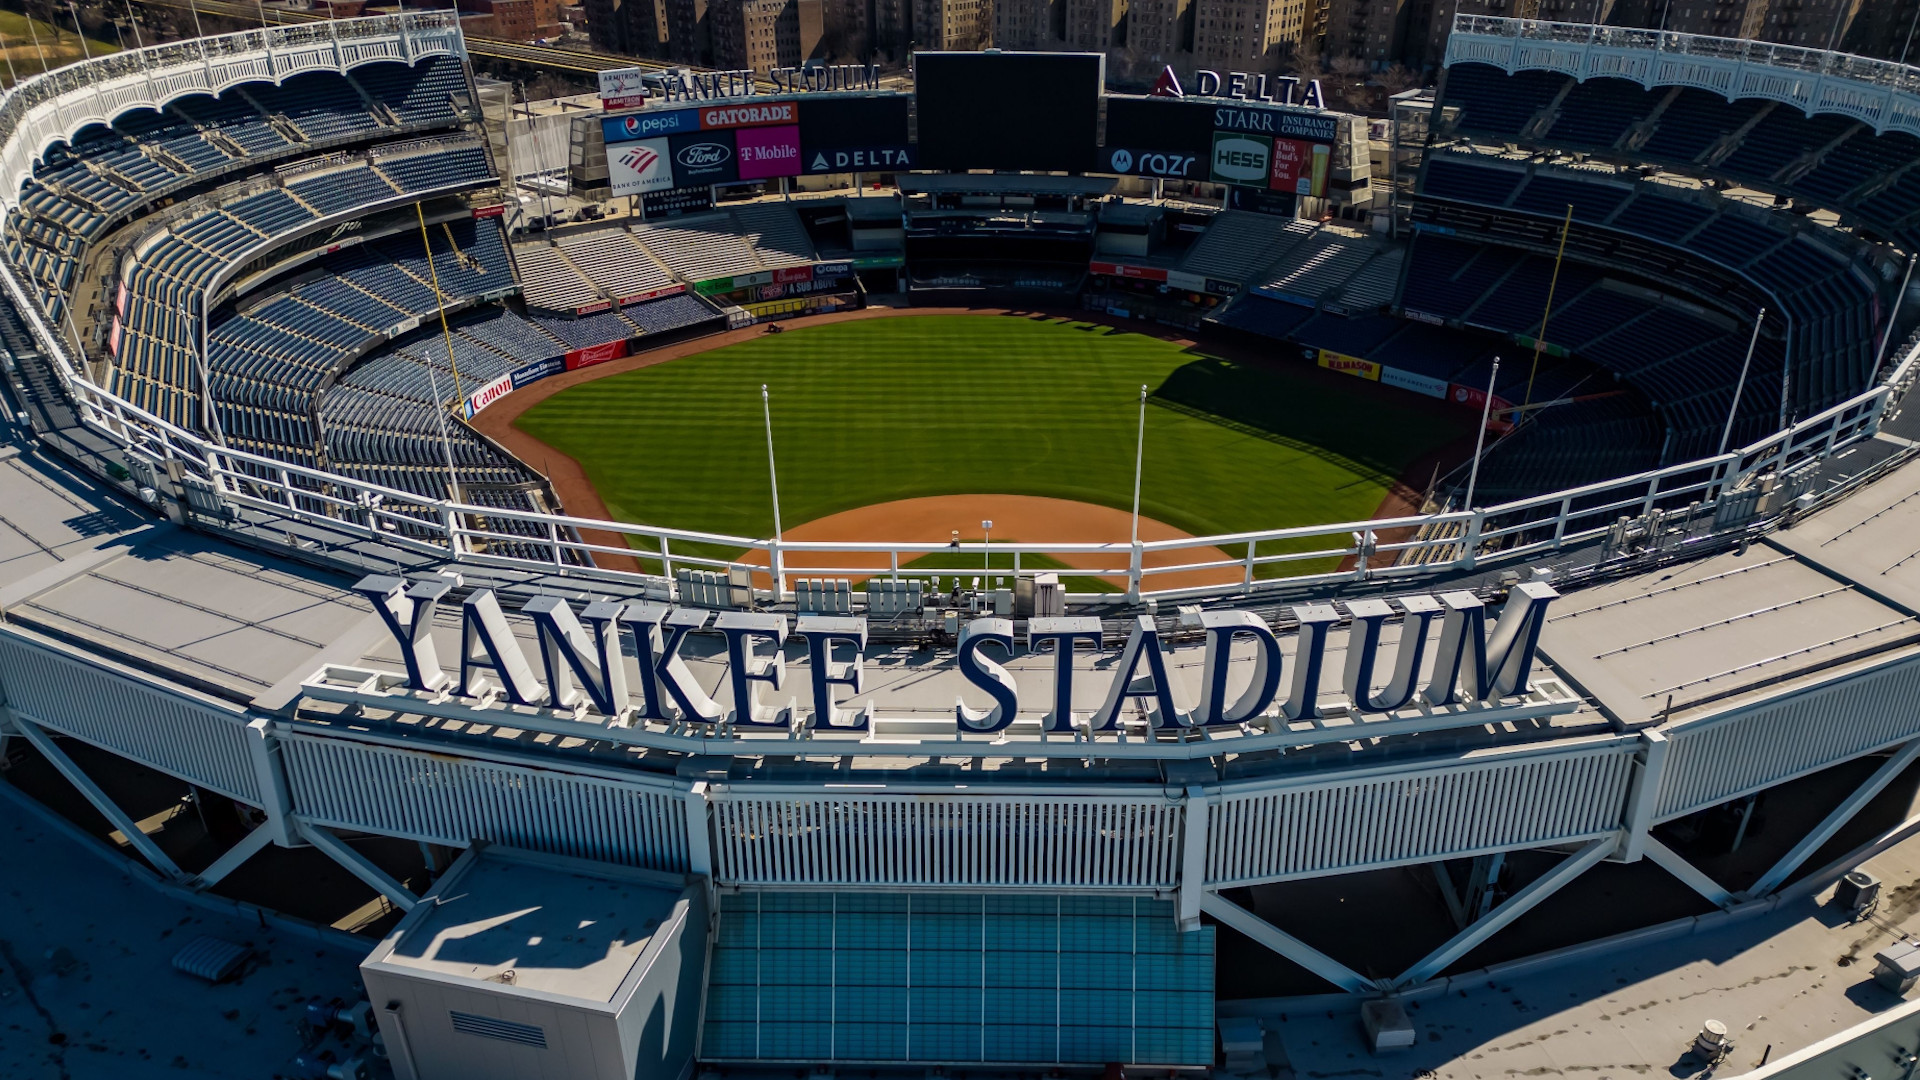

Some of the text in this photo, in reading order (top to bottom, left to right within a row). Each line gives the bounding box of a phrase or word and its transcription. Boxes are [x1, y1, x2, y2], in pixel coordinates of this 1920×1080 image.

[604, 73, 639, 81] ARMITRON
[656, 64, 880, 102] YANKEE STADIUM
[1196, 69, 1327, 109] DELTA
[706, 105, 792, 126] GATORADE
[1214, 109, 1274, 131] STARR
[1282, 115, 1335, 128] INSURANCE
[643, 115, 679, 133] pepsi
[1281, 124, 1334, 139] COMPANIES
[755, 144, 797, 160] Mobile
[1277, 141, 1295, 152] This
[687, 147, 720, 164] Ford
[836, 150, 910, 167] DELTA
[1217, 150, 1264, 169] HESS
[1276, 151, 1298, 162] Bud's
[1139, 153, 1195, 176] razr
[1274, 161, 1289, 171] For
[642, 177, 671, 185] AMERICA
[1274, 169, 1291, 180] You.
[826, 264, 848, 273] coupa
[790, 283, 795, 294] A
[797, 281, 812, 292] SUB
[813, 279, 838, 290] ABOVE
[473, 379, 512, 411] Canon
[353, 573, 1559, 734] YANKEE STADIUM
